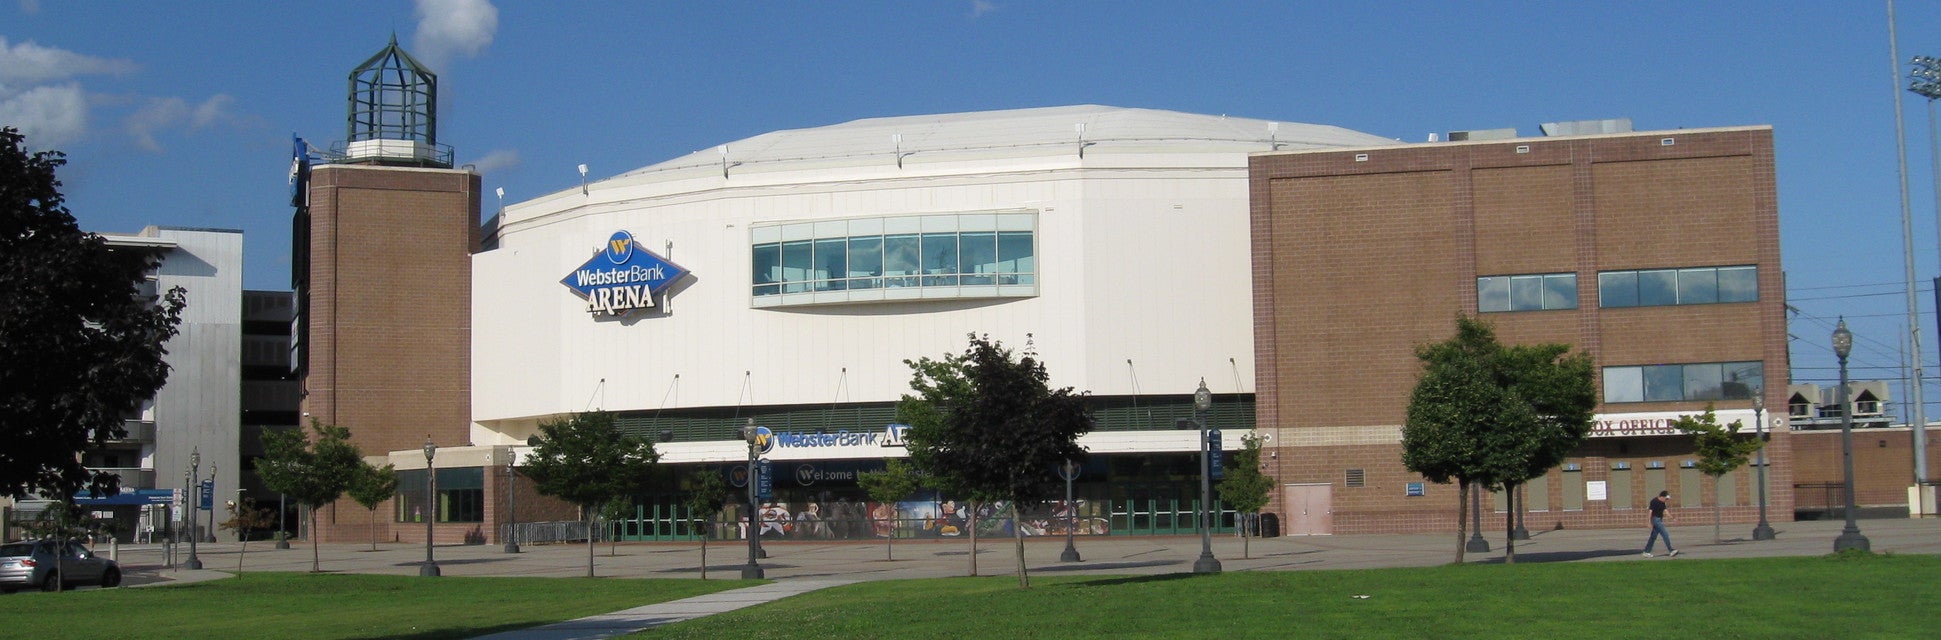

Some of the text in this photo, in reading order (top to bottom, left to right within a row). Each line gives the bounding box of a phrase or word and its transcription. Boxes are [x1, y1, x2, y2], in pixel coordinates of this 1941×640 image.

[586, 284, 655, 315] ARENA
[1587, 419, 1674, 433] OX OFFICE
